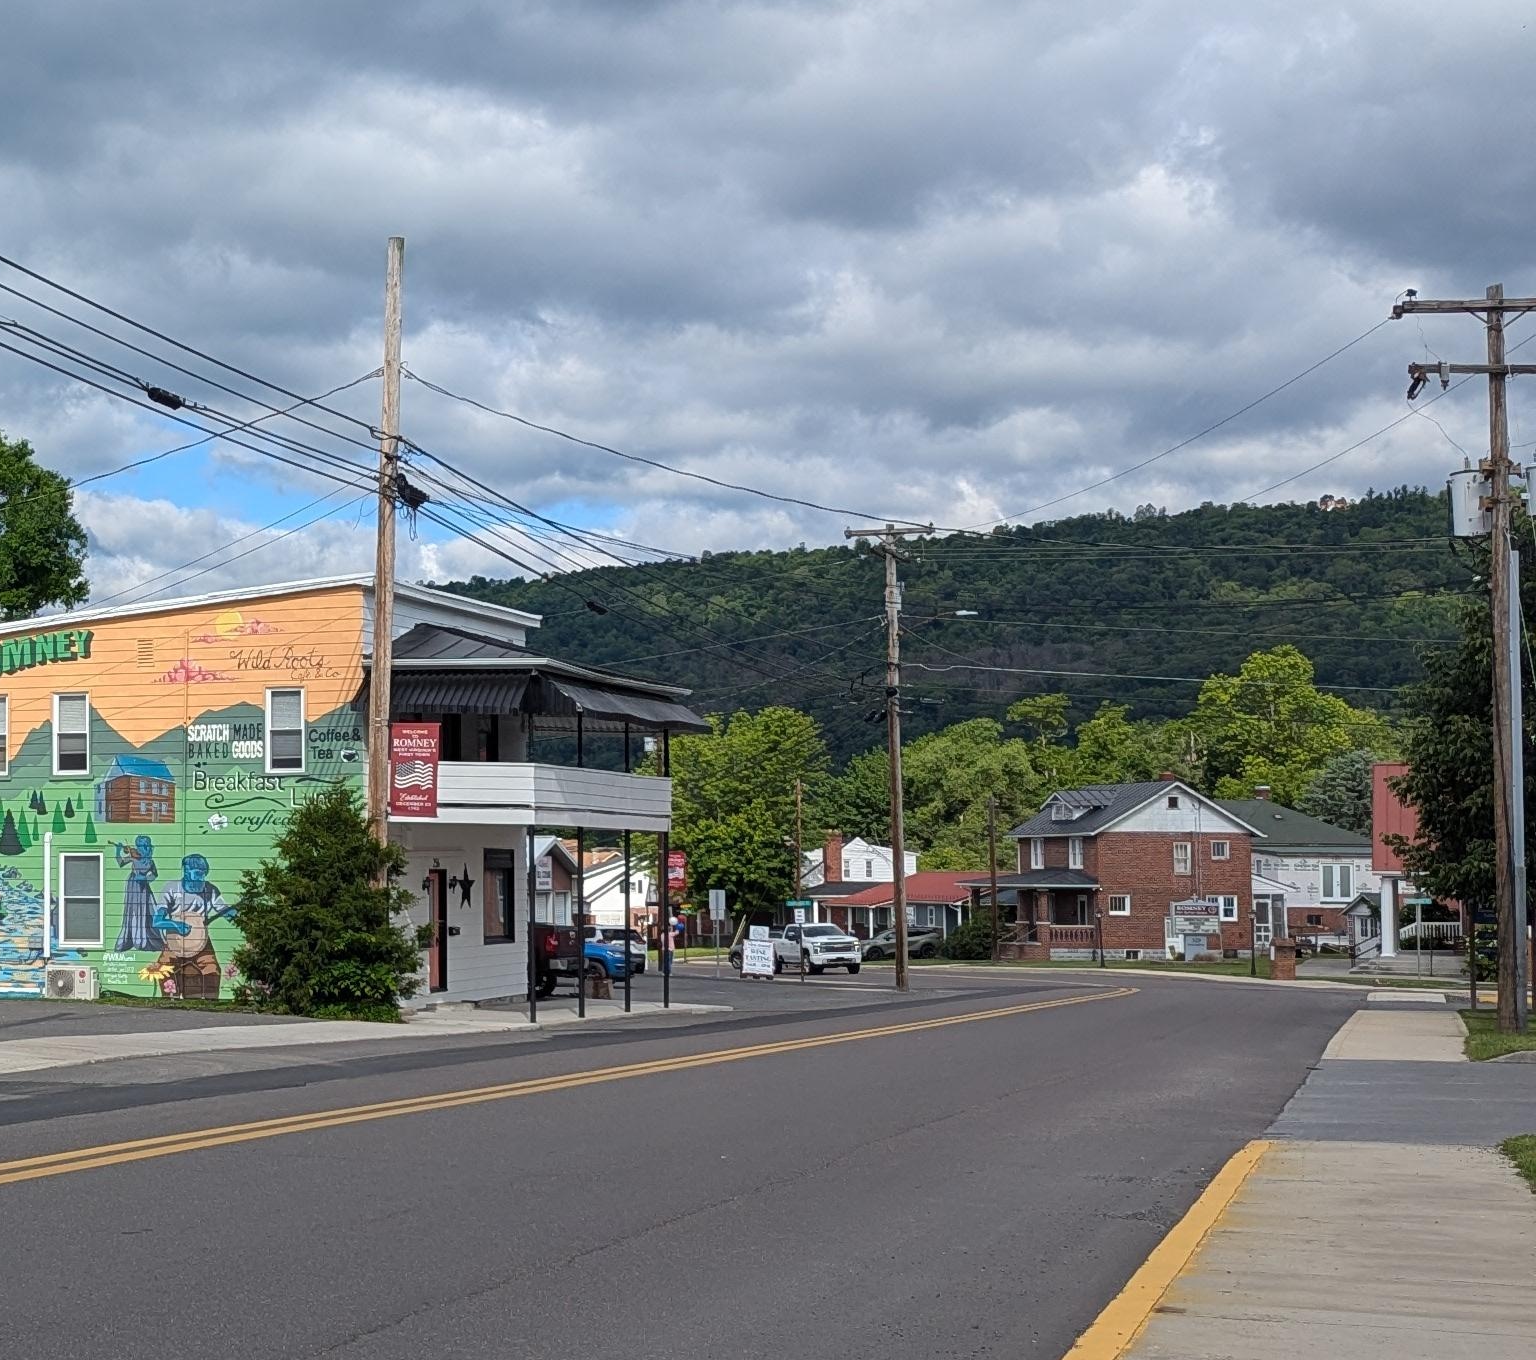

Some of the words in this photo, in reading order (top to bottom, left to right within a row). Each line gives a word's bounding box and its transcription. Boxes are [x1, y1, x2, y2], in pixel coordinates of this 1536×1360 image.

[230, 647, 276, 670] Wild
[274, 645, 326, 669] Roots
[187, 723, 230, 741] SCRATCH
[233, 723, 262, 740] MADE
[308, 728, 350, 743] Coffee
[351, 728, 362, 741] &
[188, 742, 229, 758] BAKED
[232, 740, 264, 758] GOODS
[393, 738, 437, 747] ROMNEY
[310, 746, 334, 760] Tea
[192, 770, 286, 792] Breakfast
